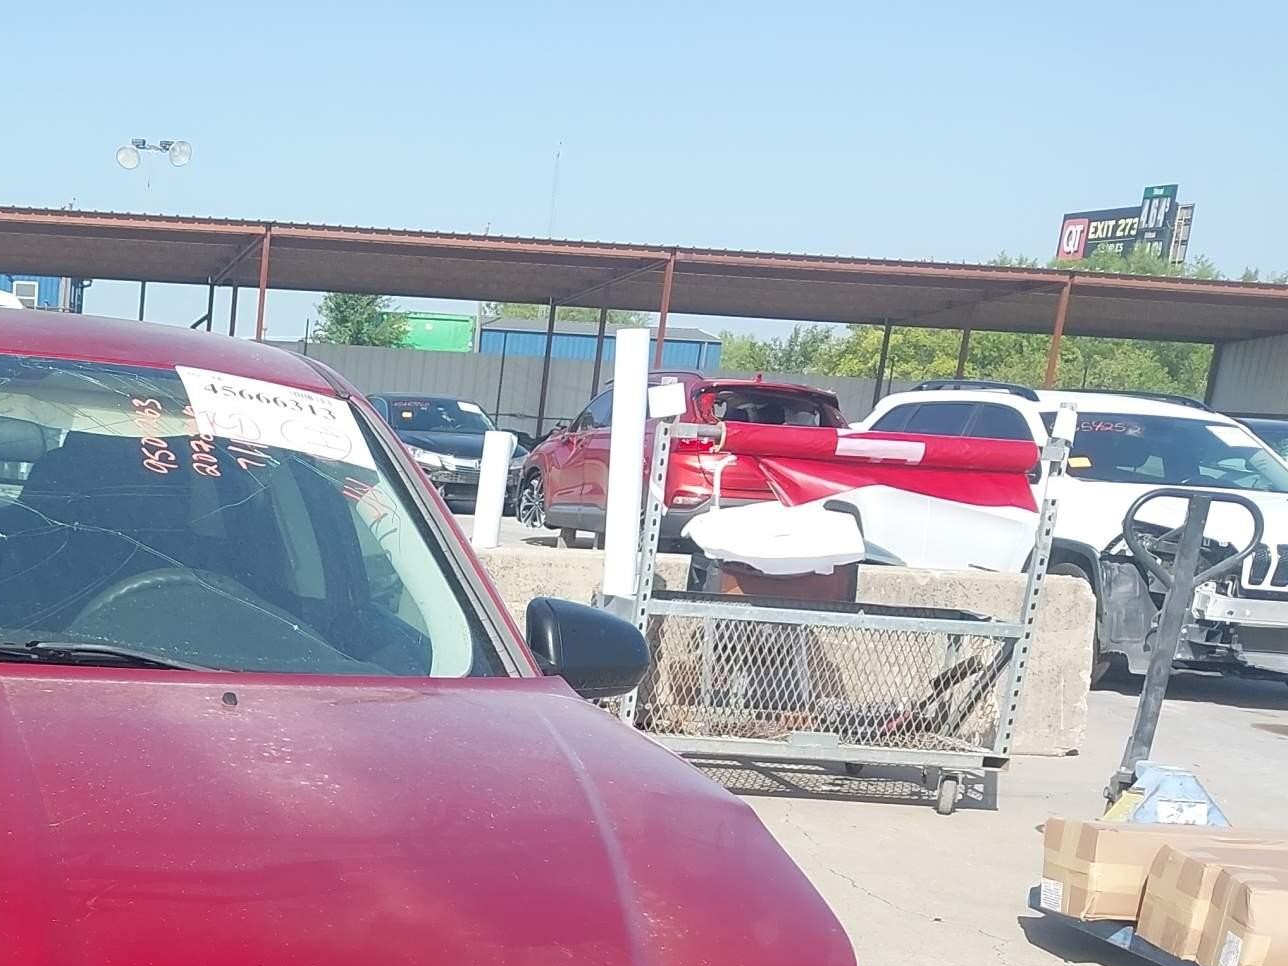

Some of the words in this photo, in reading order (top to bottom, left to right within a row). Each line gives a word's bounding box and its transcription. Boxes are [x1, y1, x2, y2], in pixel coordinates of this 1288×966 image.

[1063, 224, 1084, 254] QT
[1088, 220, 1117, 239] EXIT
[1116, 217, 1140, 237] 273
[204, 383, 336, 420] 45666313
